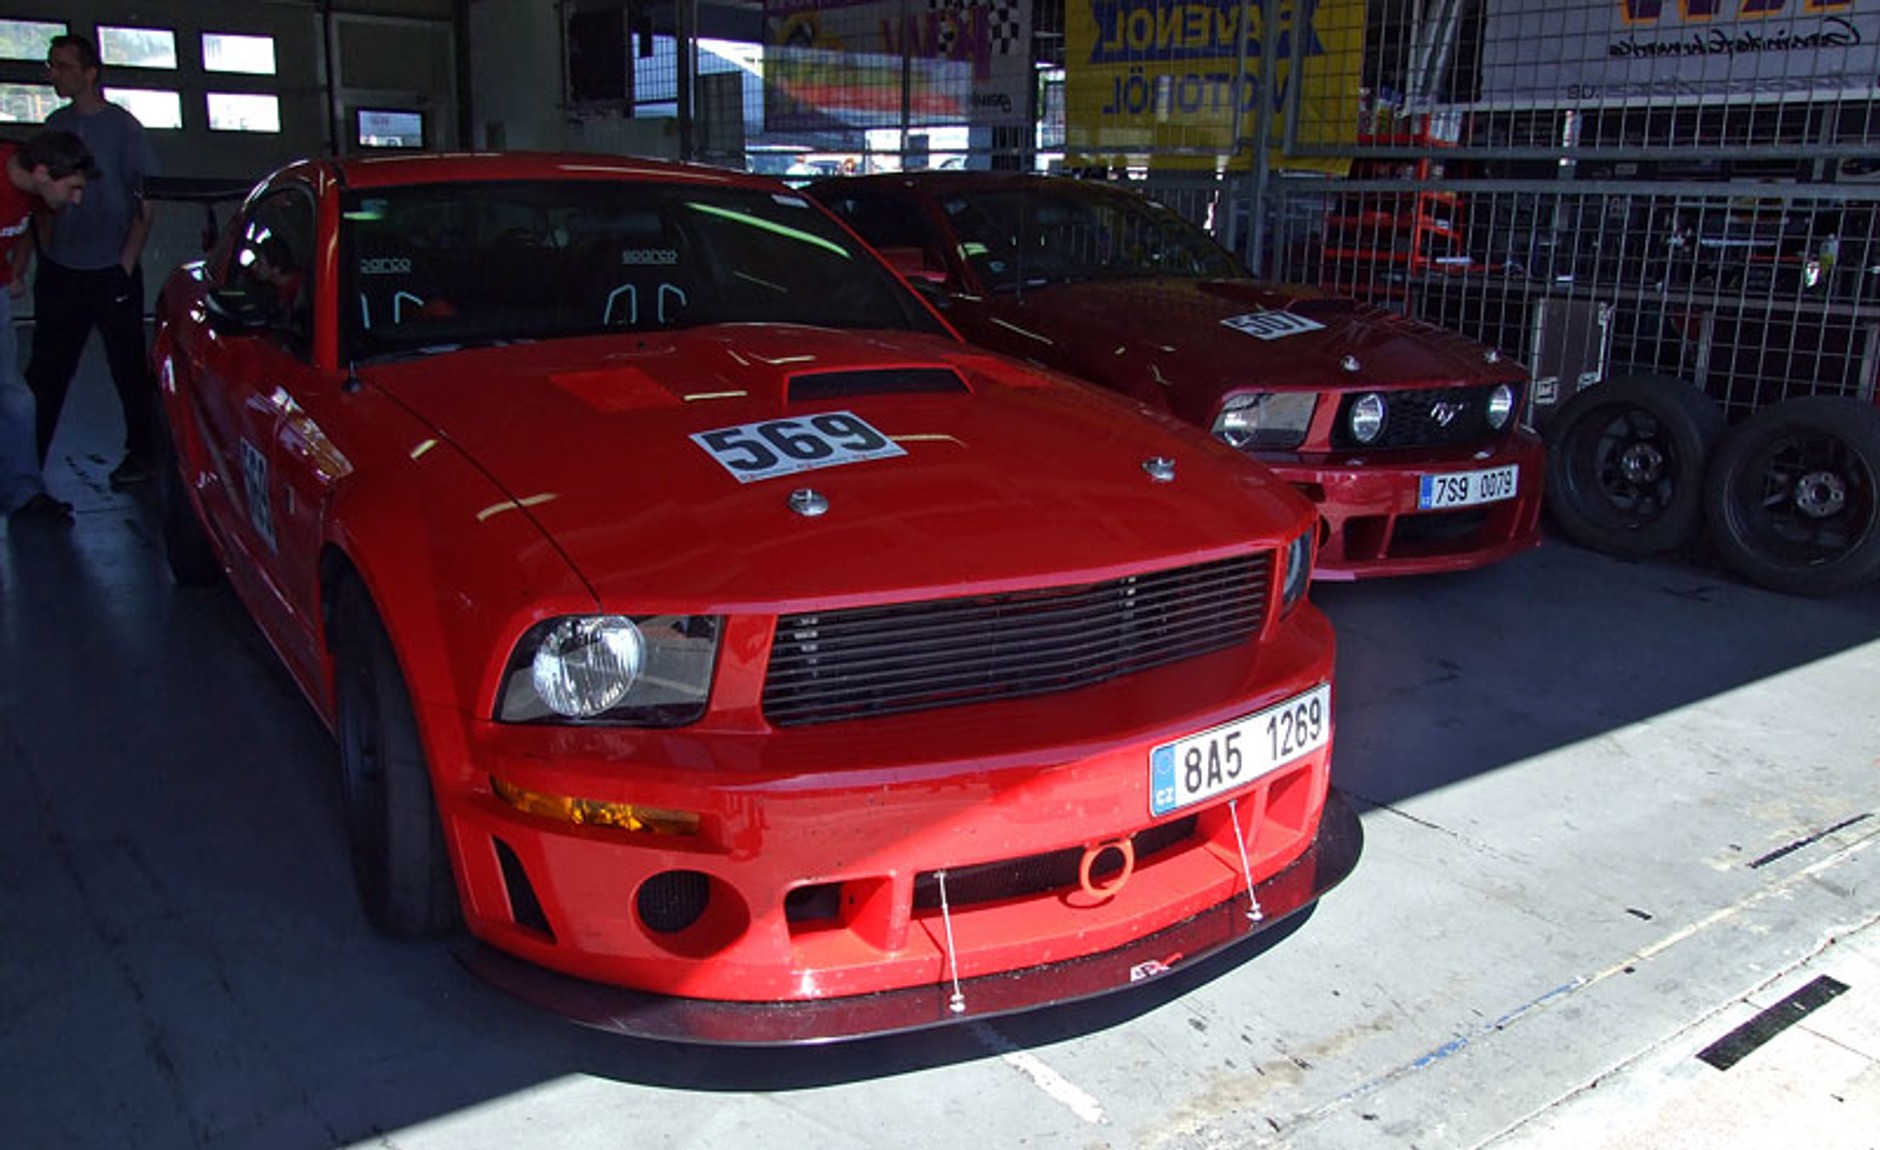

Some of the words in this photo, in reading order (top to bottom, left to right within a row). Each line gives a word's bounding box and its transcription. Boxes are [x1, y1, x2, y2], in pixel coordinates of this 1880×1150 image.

[700, 414, 888, 471] 569
[1436, 477, 1468, 504] 7S9
[1184, 731, 1242, 793] 8A5
[1266, 697, 1322, 761] 1269
[1156, 786, 1174, 806] CZ
